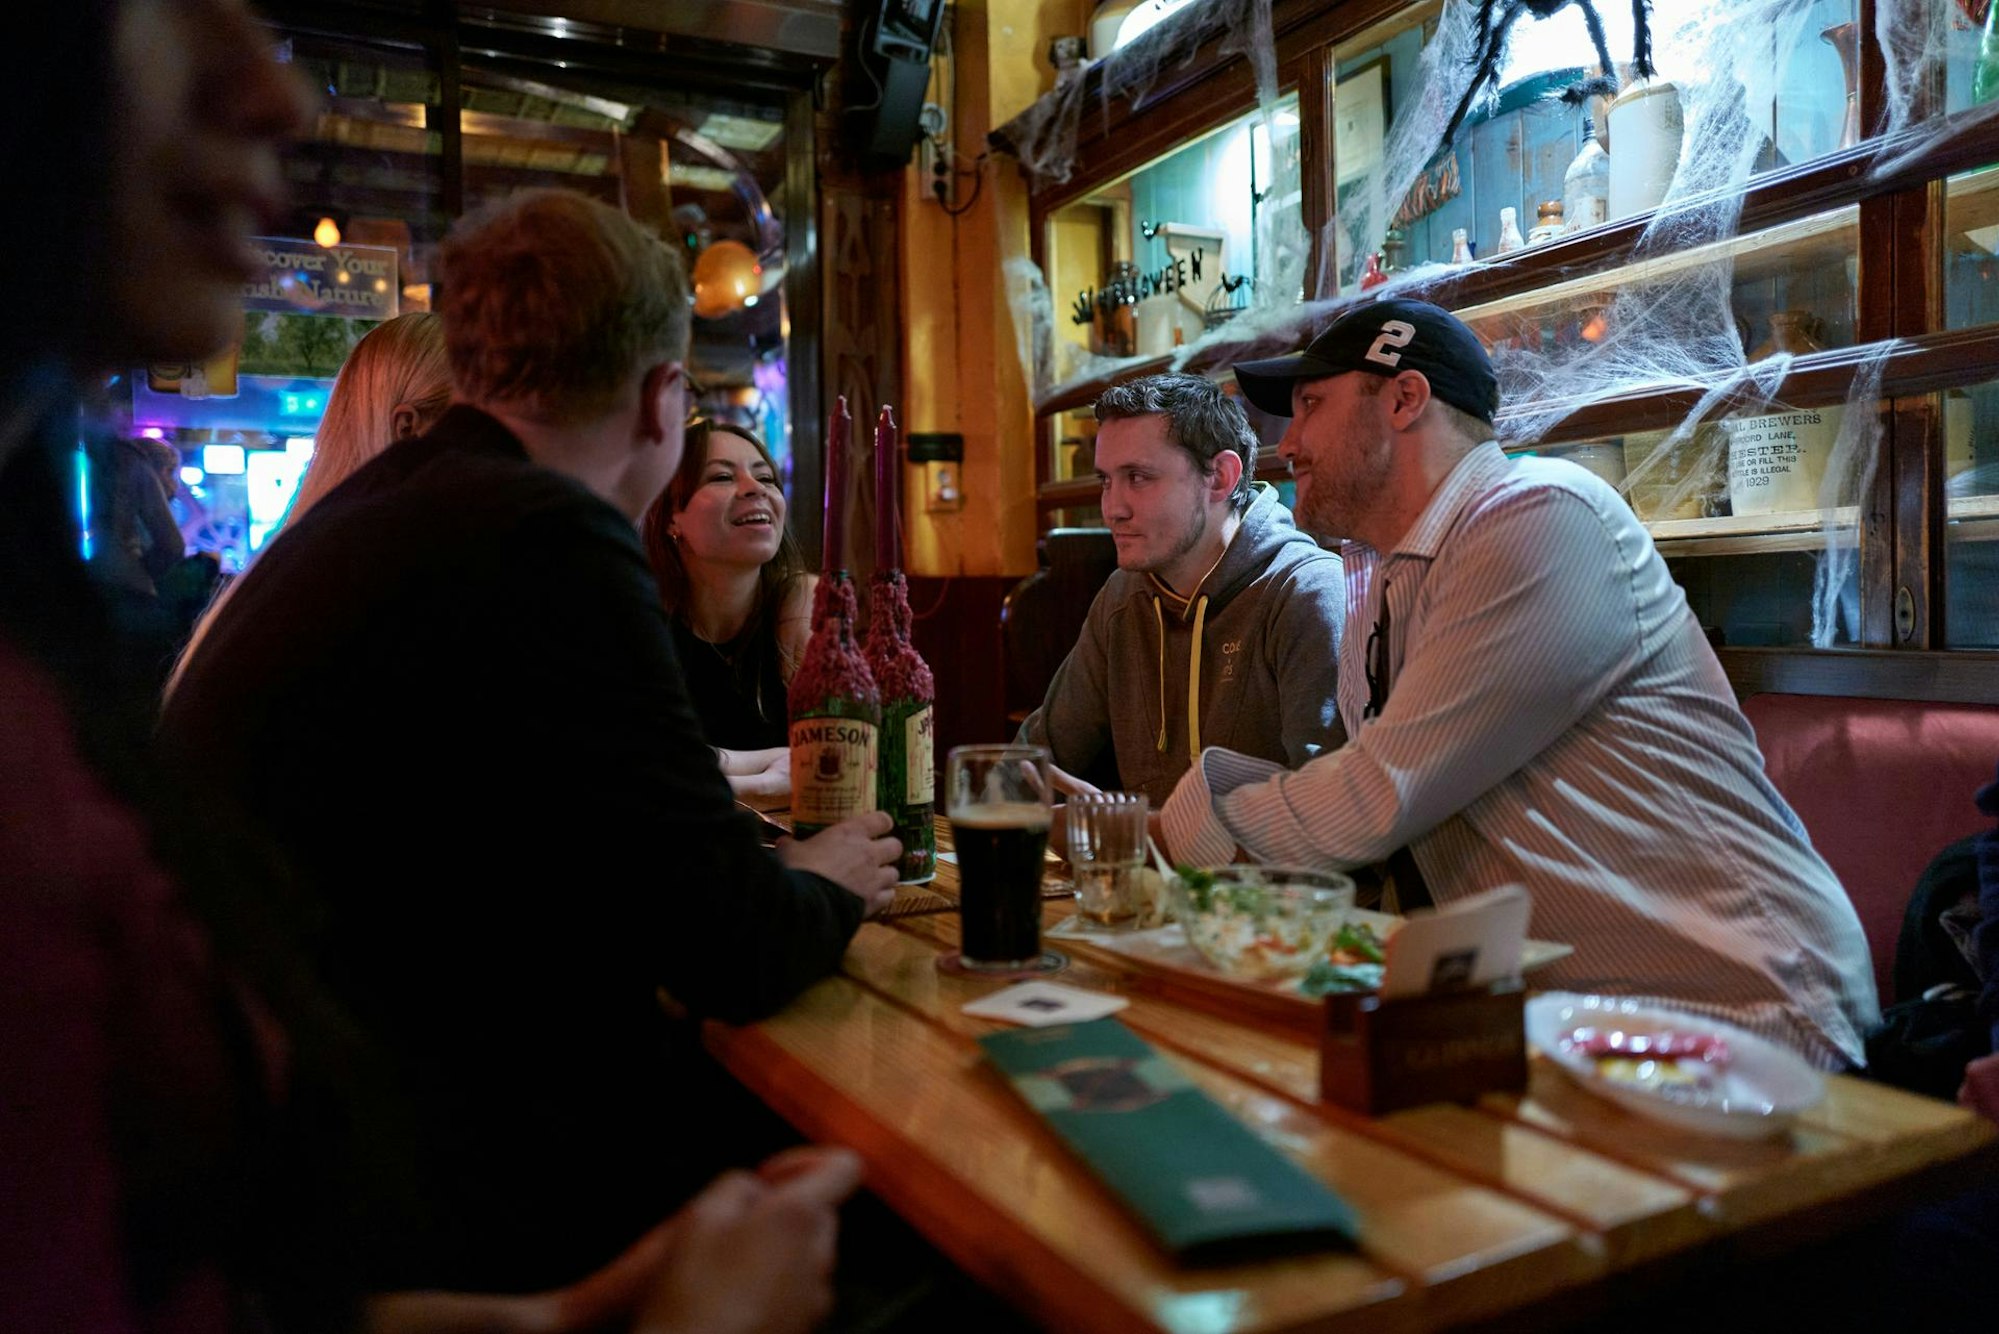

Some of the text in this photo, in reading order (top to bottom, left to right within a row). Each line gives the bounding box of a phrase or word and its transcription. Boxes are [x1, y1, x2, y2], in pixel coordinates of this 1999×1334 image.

[260, 250, 388, 276] cover Your
[1365, 320, 1416, 367] 2
[1749, 413, 1822, 431] BREWERS
[1747, 458, 1757, 466] OR
[1759, 457, 1774, 465] FILL
[1777, 455, 1797, 463] THIS
[1751, 467, 1758, 475] IS
[1760, 465, 1792, 475] ILLEGAL
[1746, 476, 1770, 488] 1929
[793, 726, 870, 748] JAMESON
